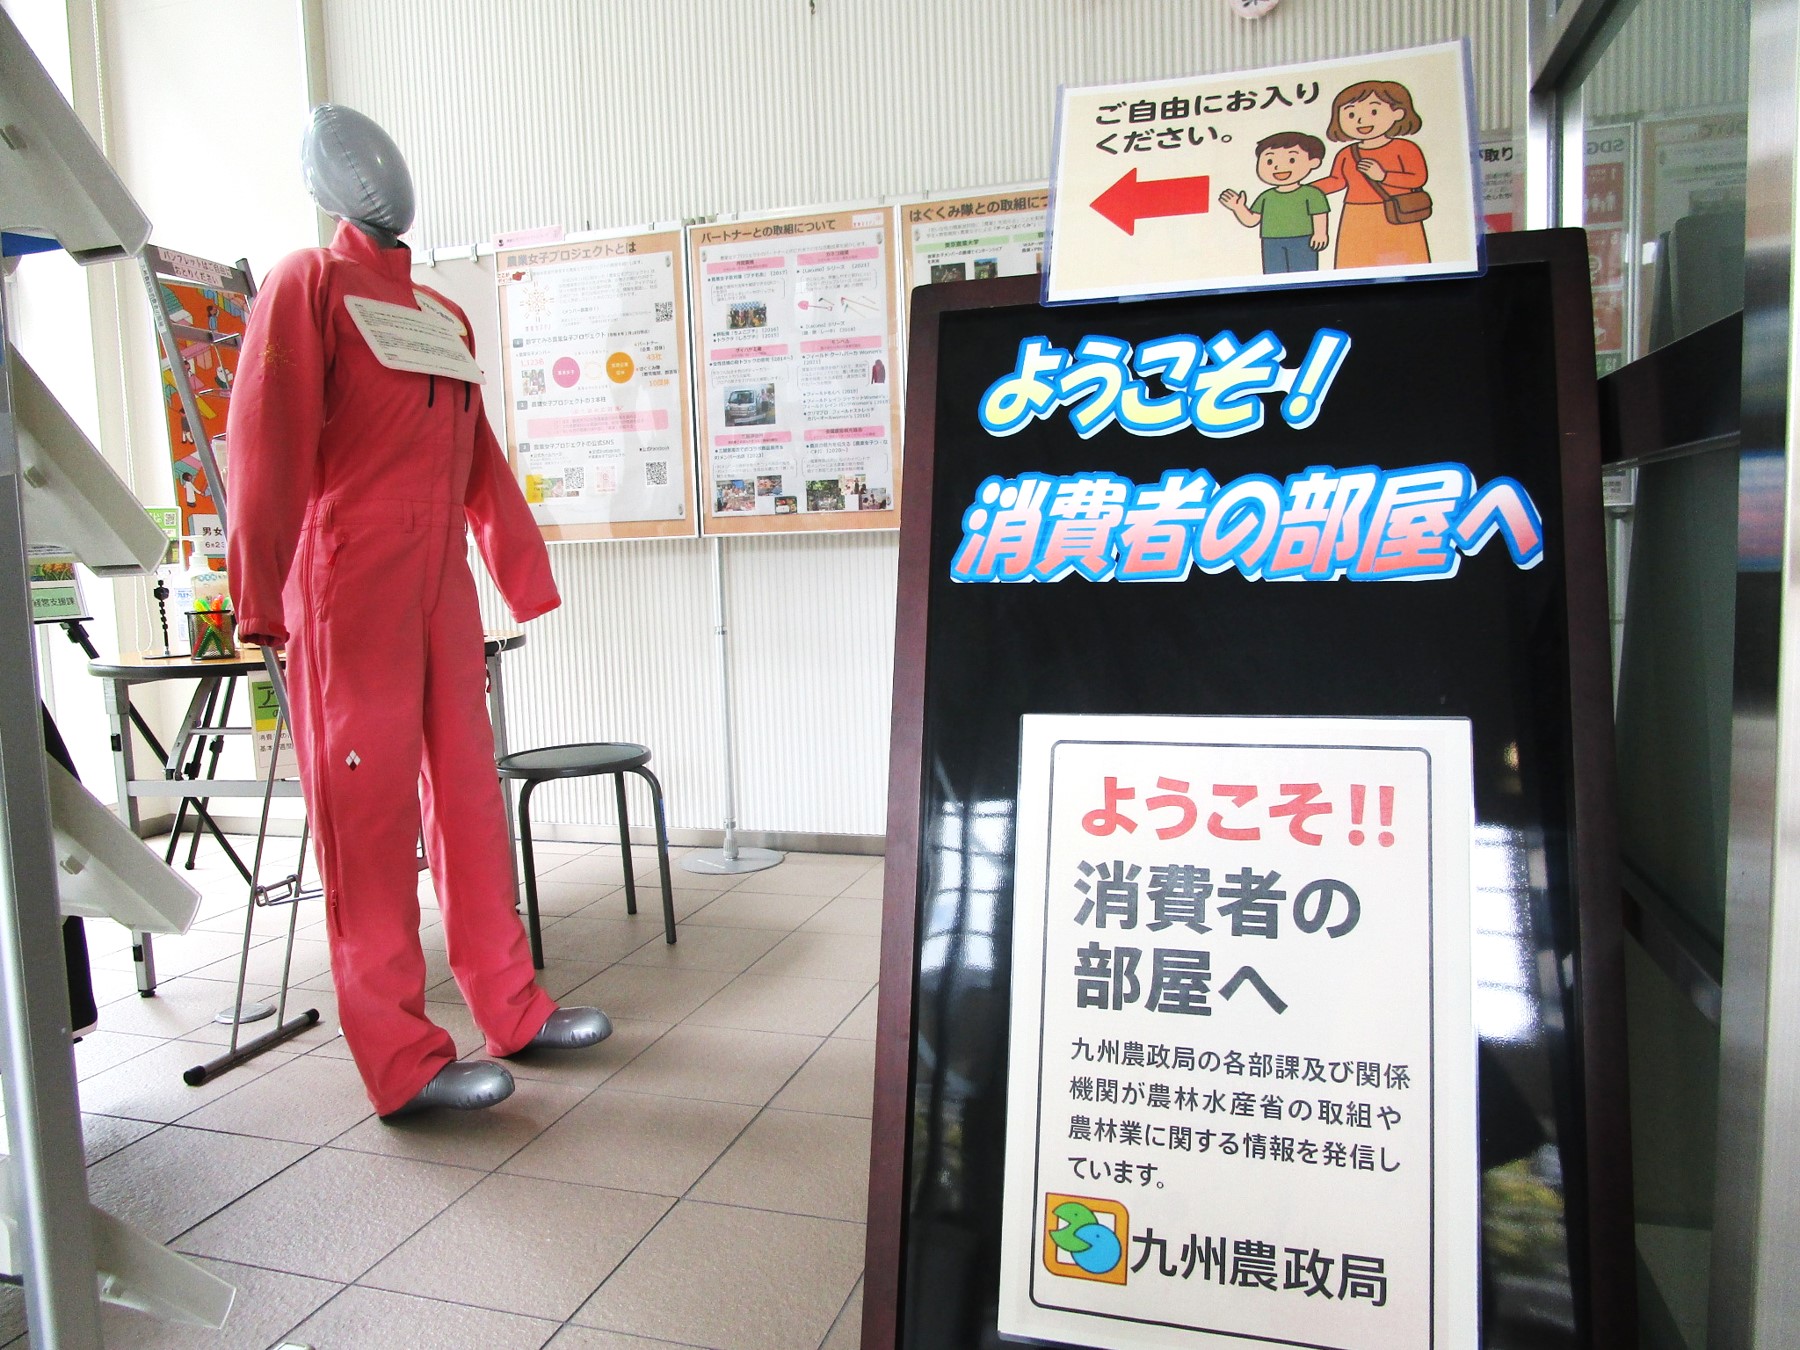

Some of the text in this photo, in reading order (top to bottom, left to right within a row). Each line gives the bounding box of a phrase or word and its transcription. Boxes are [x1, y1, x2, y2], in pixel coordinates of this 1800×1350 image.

[1095, 82, 1320, 125] ご自由にお入り
[1095, 125, 1233, 156] ください。
[507, 241, 636, 267] 農業女子プロジェクトとは
[701, 219, 836, 243] パートナーとの取組について
[978, 328, 1351, 439] ようこそ！
[949, 461, 1543, 584] 消費者の部屋へ
[1081, 776, 1395, 848] ようこそ！！
[1073, 860, 1361, 939] 消費者の
[1073, 941, 1288, 1016] 部屋へ
[1070, 1036, 1411, 1091] 九州農政局の各部課及び関係
[1069, 1075, 1402, 1131] 機関が農林水産省の取組や
[1067, 1114, 1401, 1173] 農林業に関する情報を発信し
[1067, 1155, 1165, 1189] ています。
[1130, 1227, 1389, 1307] 九州農政局
